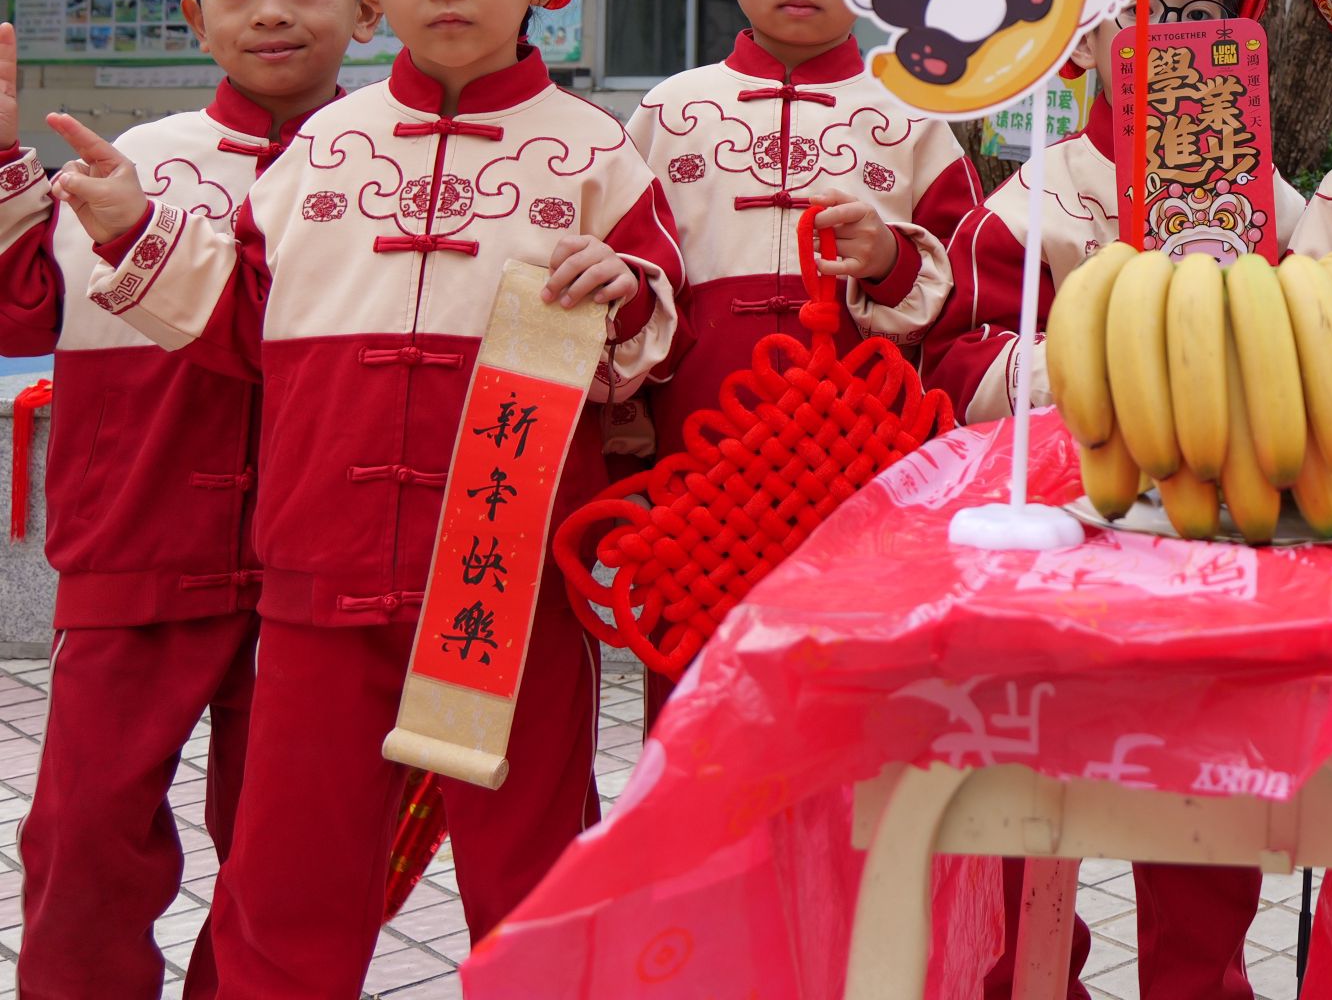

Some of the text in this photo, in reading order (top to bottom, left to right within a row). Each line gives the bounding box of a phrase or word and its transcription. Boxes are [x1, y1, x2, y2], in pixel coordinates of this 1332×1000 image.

[1164, 31, 1207, 41] TOGETHER
[1213, 44, 1237, 55] LUCK
[1214, 53, 1238, 65] TEAM
[440, 391, 539, 666] 新年快樂
